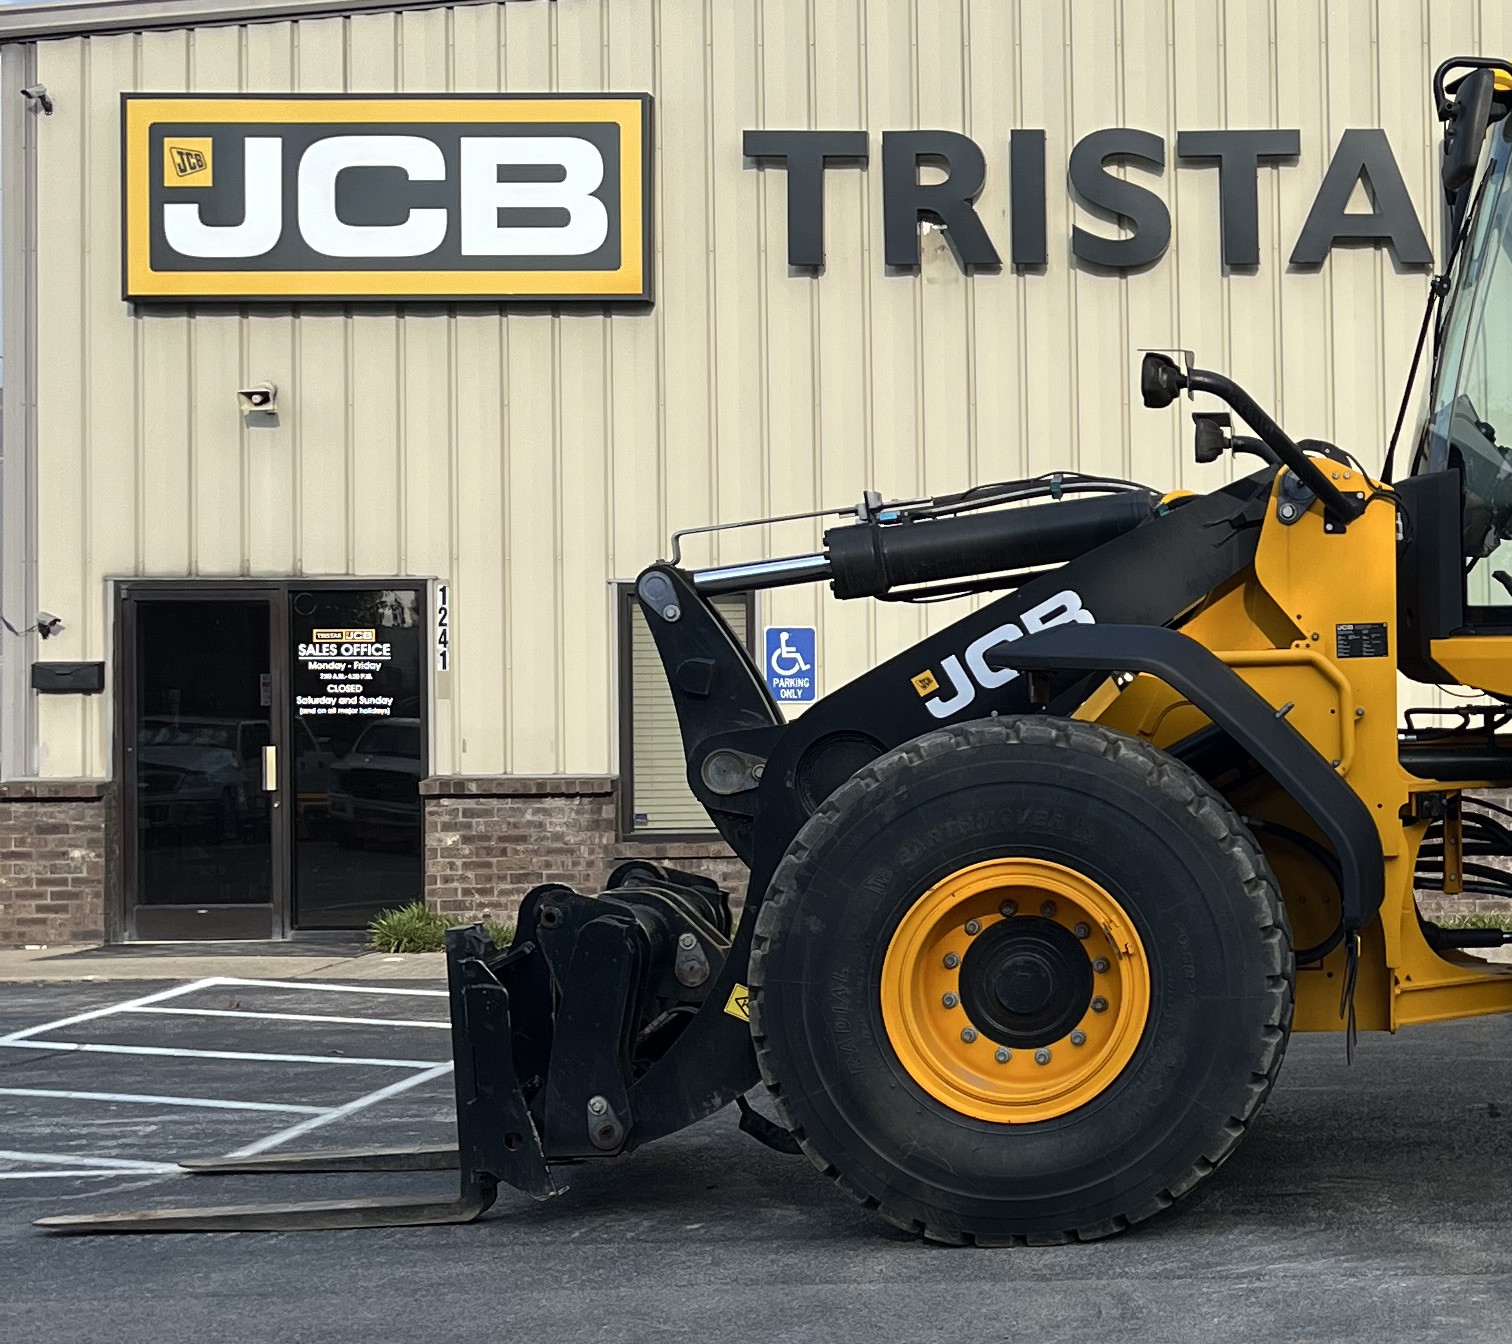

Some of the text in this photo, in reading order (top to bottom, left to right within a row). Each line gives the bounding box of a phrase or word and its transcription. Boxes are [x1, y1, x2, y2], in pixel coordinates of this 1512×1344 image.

[176, 150, 204, 173] JCB
[164, 135, 608, 258] JCB
[438, 585, 448, 670] 1241
[345, 631, 373, 640] JCB
[298, 643, 391, 656] SALES OFFICE
[925, 590, 1096, 719] JCB
[308, 661, 347, 671] Monday
[354, 661, 382, 671] Friday
[326, 684, 363, 693] CLOSED
[773, 678, 810, 688] PARKING
[780, 689, 803, 699] ONLY
[296, 696, 394, 706] Saturday and Sunday
[827, 964, 866, 1076] RADIAL
